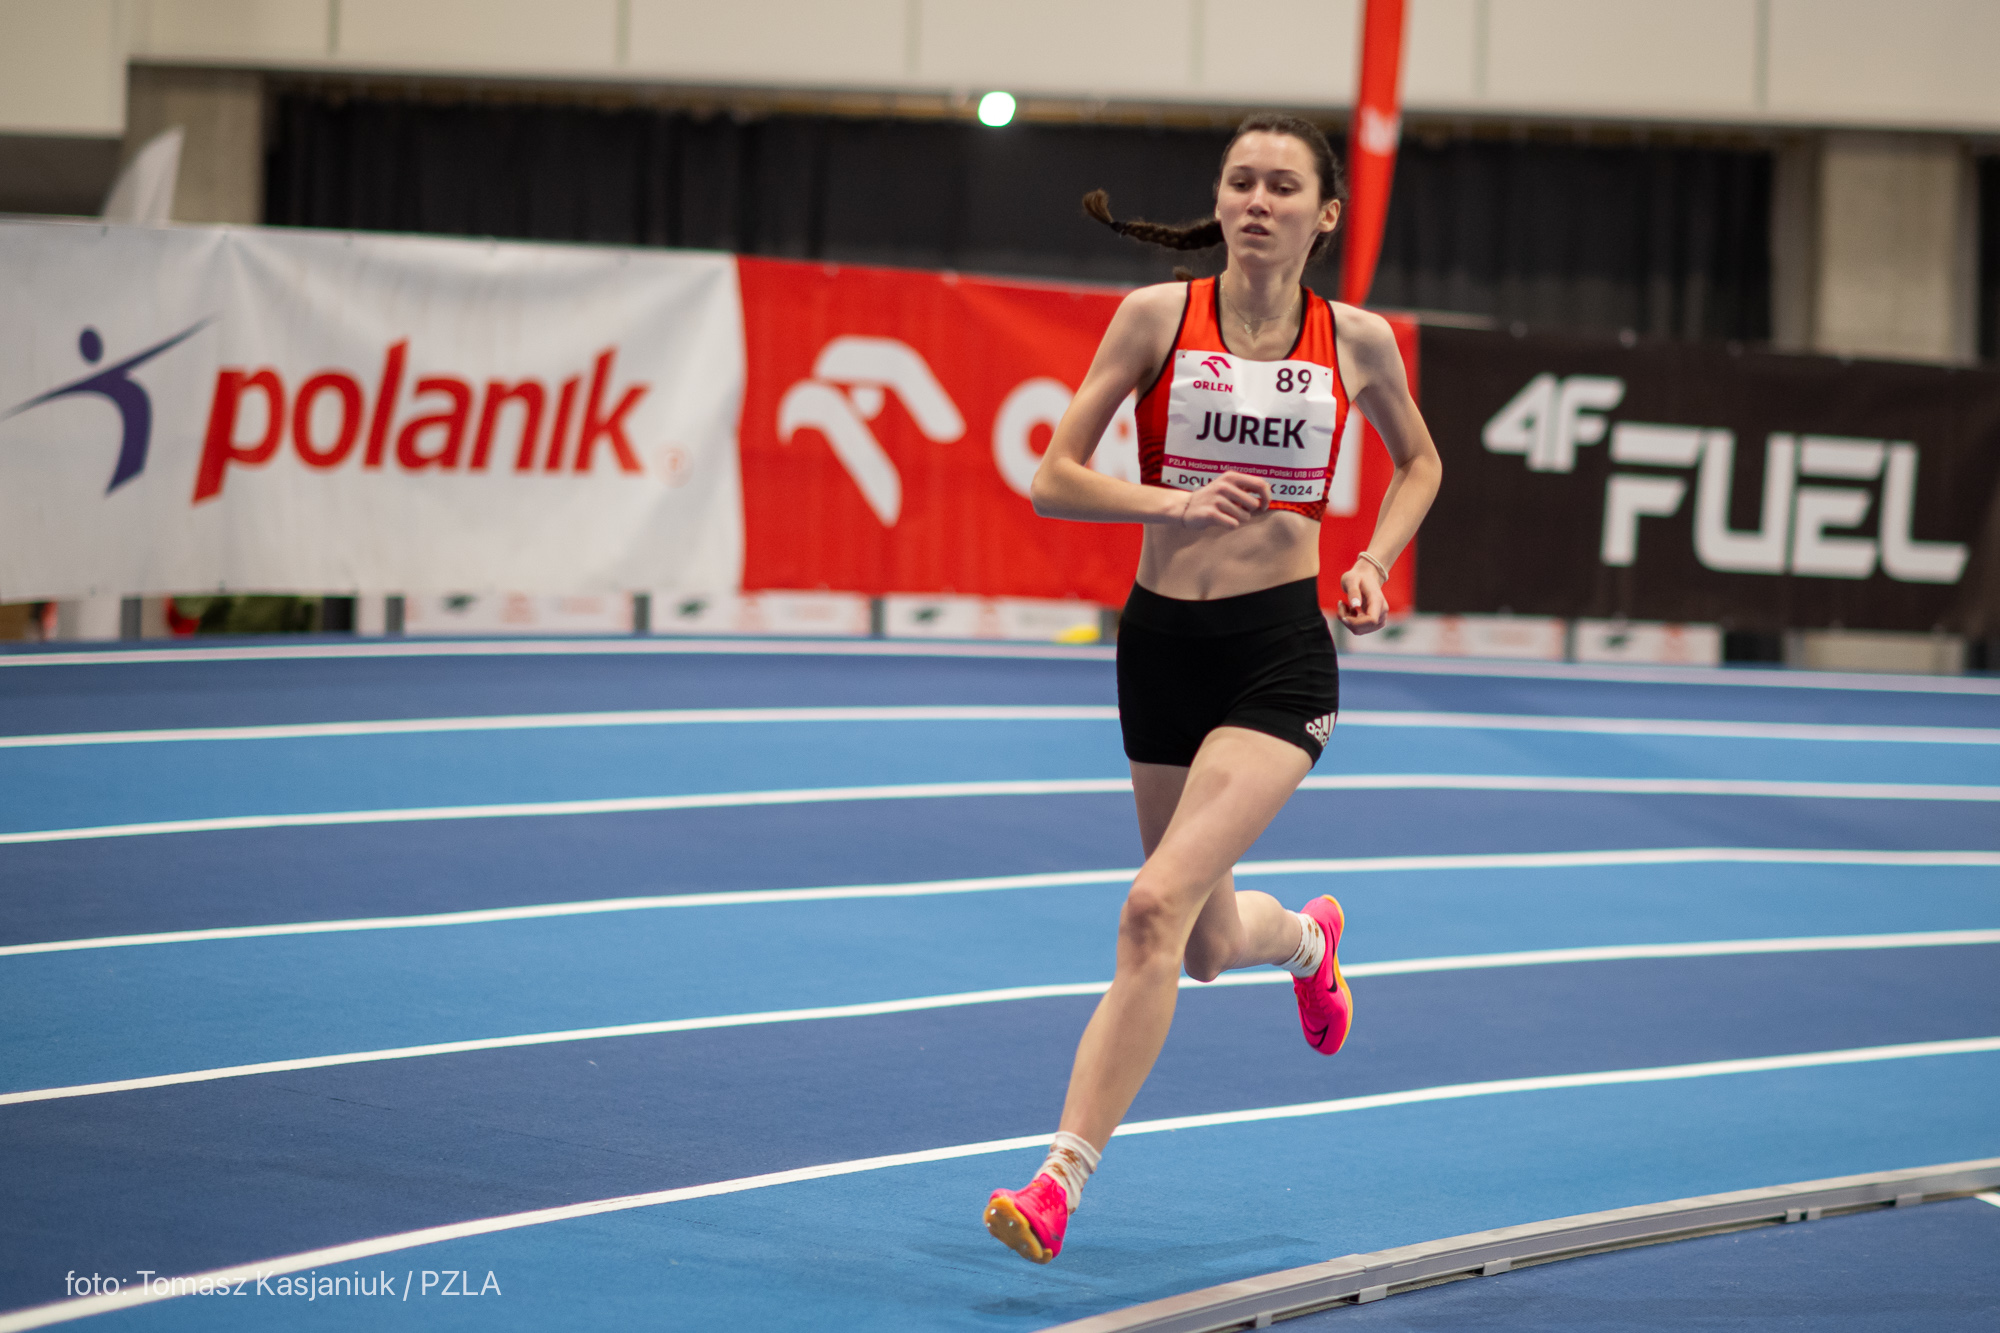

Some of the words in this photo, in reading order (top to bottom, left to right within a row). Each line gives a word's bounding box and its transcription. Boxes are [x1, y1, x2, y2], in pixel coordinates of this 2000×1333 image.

[1193, 380, 1233, 393] ORLEN
[1276, 368, 1312, 393] 89
[1196, 411, 1307, 449] JUREK
[1483, 372, 1624, 473] 4F
[1168, 458, 1186, 466] PZLA
[1270, 469, 1292, 477] Polski
[1280, 484, 1312, 496] 2024
[1602, 421, 1968, 584] FUEL
